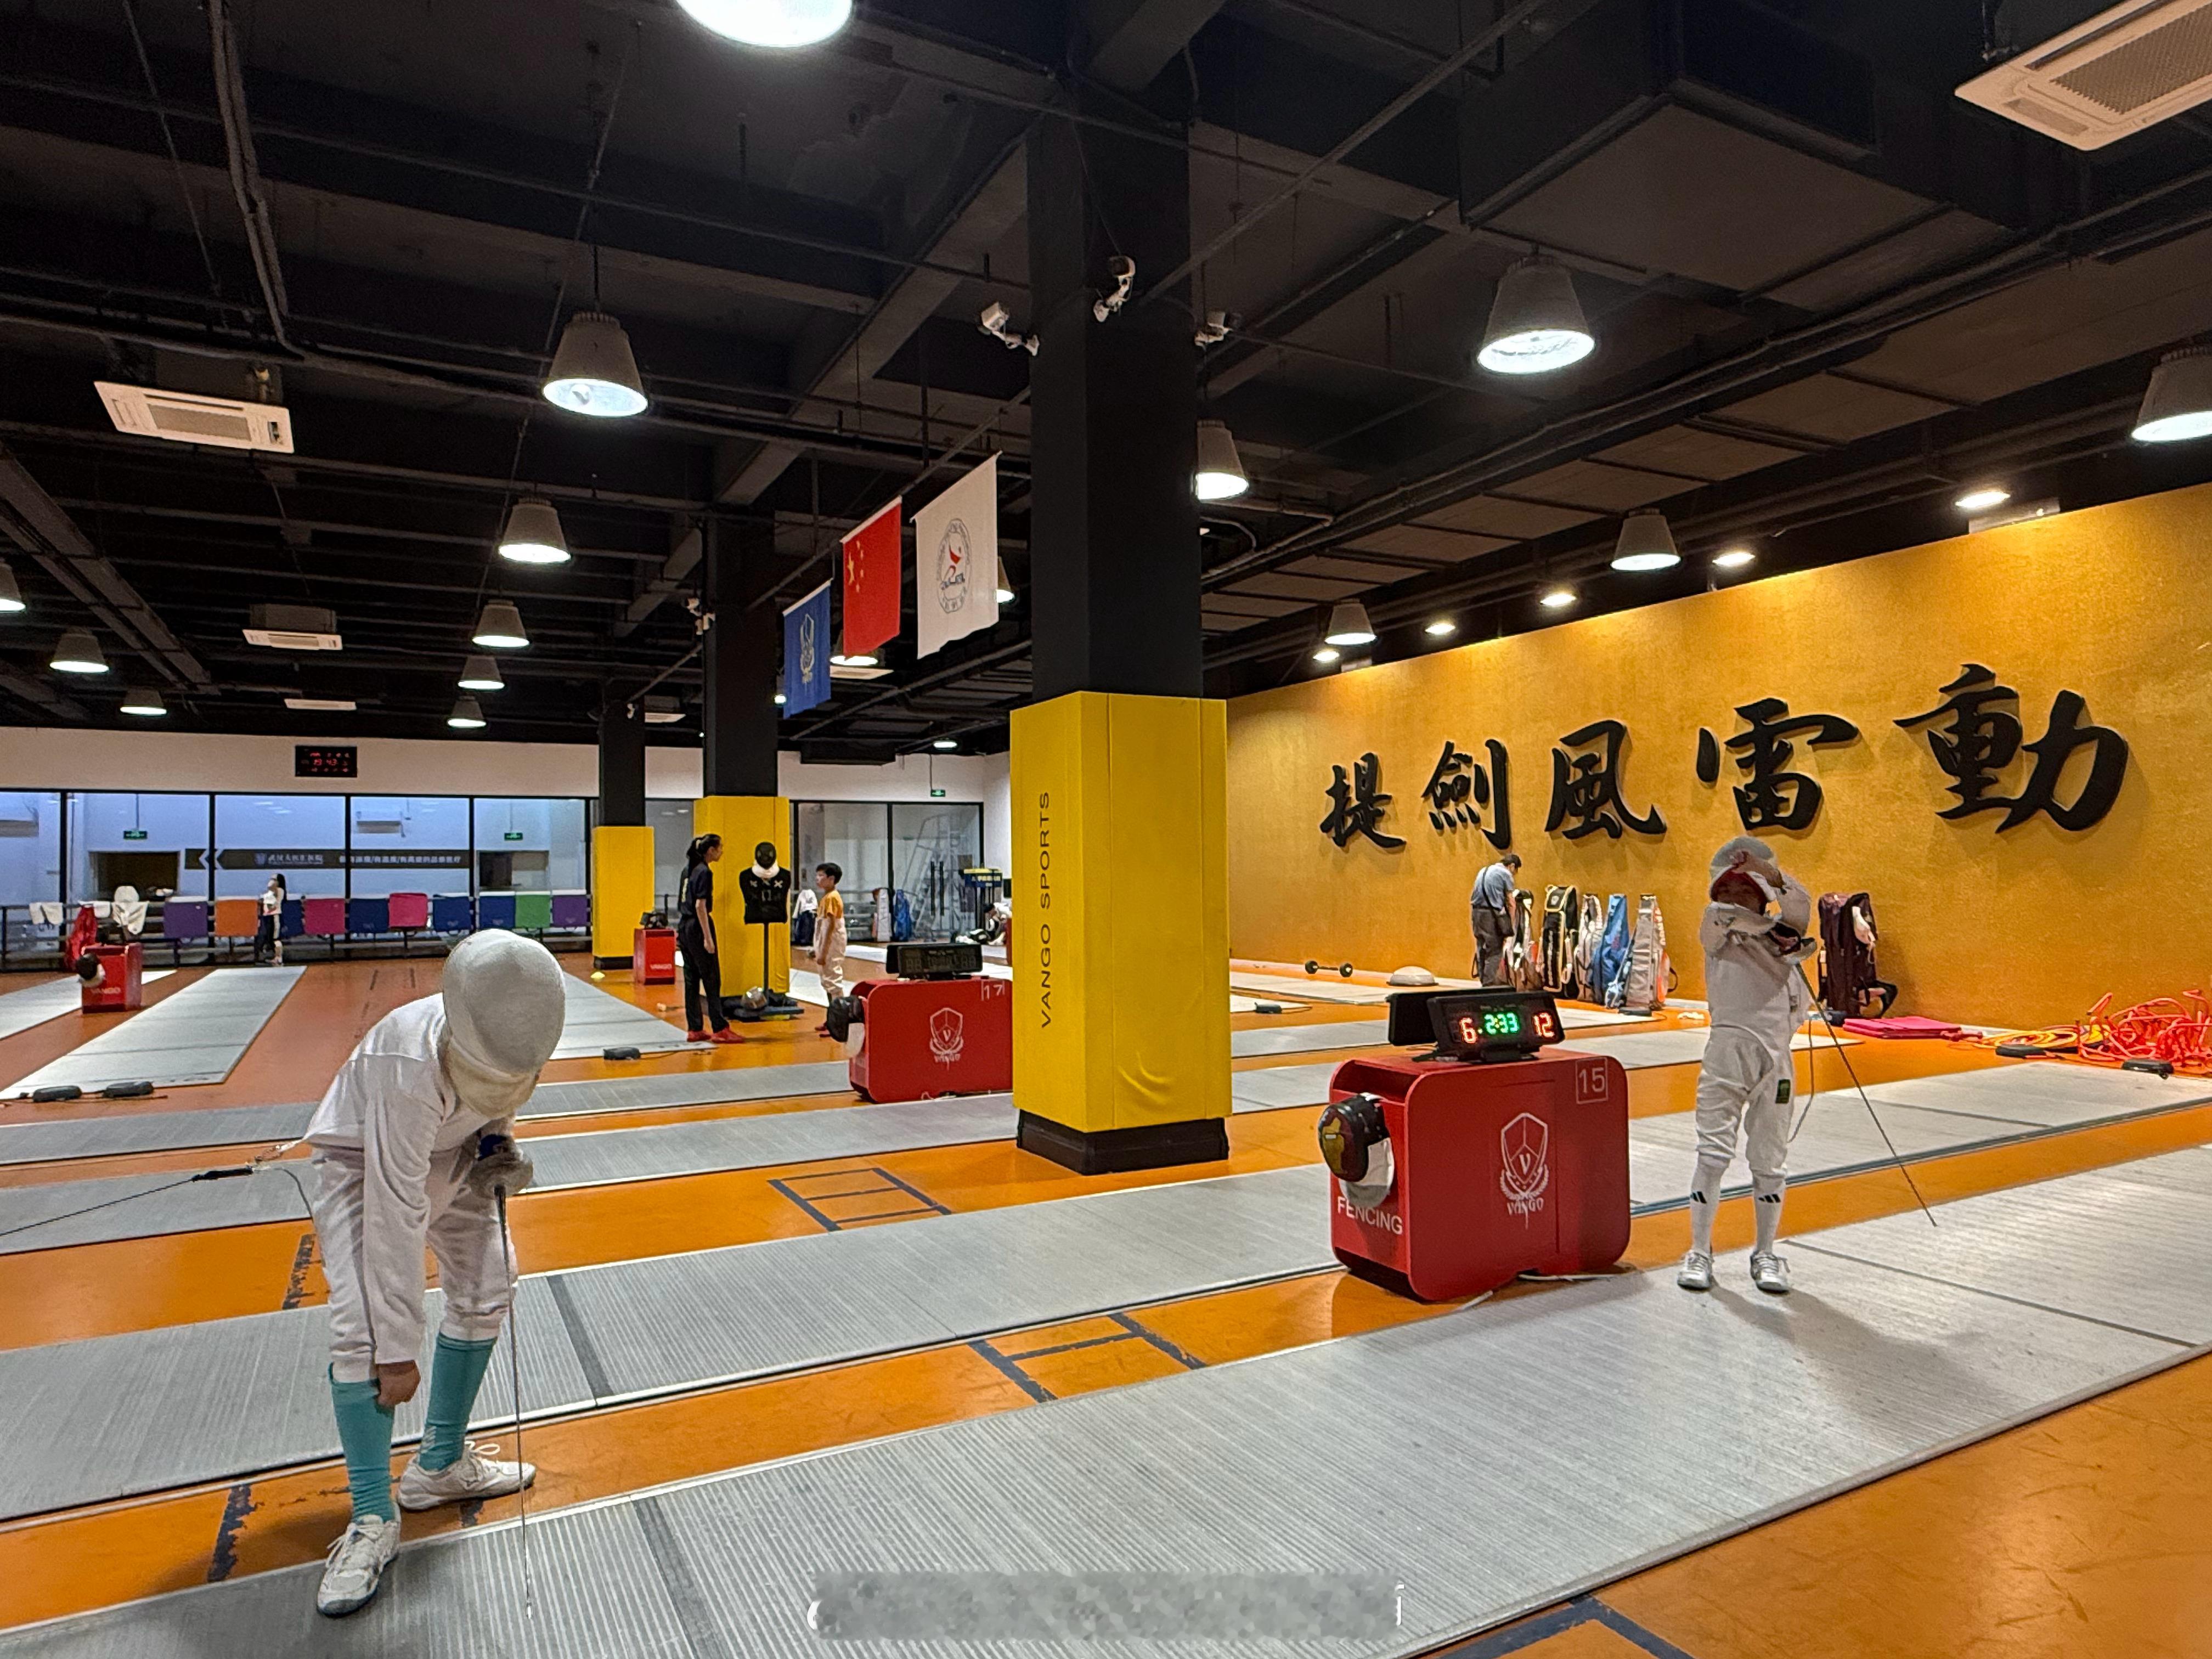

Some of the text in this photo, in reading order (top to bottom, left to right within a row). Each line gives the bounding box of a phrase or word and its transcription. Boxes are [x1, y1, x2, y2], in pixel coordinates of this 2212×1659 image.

[1040, 792, 1052, 1029] VANGO SPORTS
[984, 984, 1003, 1000] 17
[1483, 1013, 1519, 1035] 2:33
[1532, 1013, 1555, 1037] 12
[1579, 1067, 1605, 1094] 15
[1338, 1196, 1403, 1235] FENCING
